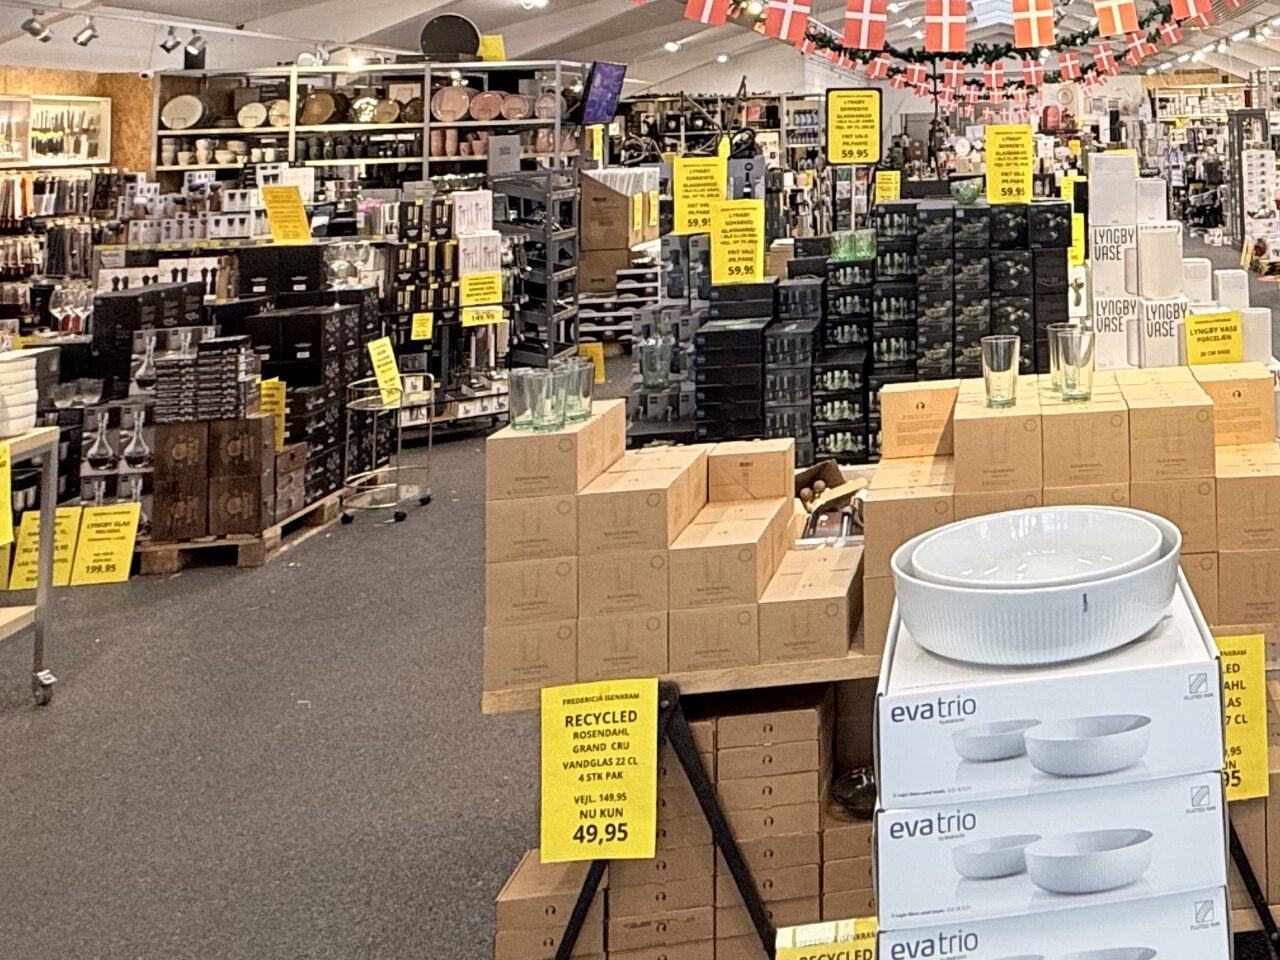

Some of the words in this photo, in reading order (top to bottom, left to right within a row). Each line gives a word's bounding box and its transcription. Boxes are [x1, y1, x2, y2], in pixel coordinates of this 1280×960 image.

[841, 149, 869, 159] 59,95
[1001, 187, 1025, 197] 59,95
[1093, 228, 1135, 245] LYNGBY
[1094, 244, 1122, 261] VASE
[727, 265, 755, 276] 59,95
[1096, 299, 1137, 317] LYNGBY
[1145, 301, 1188, 321] LYNGBY
[1096, 316, 1124, 333] VASE
[1146, 320, 1175, 338] VASE
[1190, 326, 1218, 336] LYNGBY
[1219, 325, 1238, 333] VASE
[86, 563, 117, 574] 199,95
[1224, 680, 1246, 690] AHL
[562, 694, 604, 706] FREDERICIA
[604, 692, 640, 702] ISENKRAM
[1225, 697, 1242, 708] AS
[564, 710, 638, 728] RECYCLED
[1234, 714, 1248, 725] CL
[573, 728, 630, 740] ROSENDAHL
[572, 743, 607, 754] GRAND
[611, 741, 630, 751] CRU
[562, 757, 613, 770] VANDGLAS
[615, 757, 626, 766] 22
[627, 756, 639, 766] CL
[578, 774, 585, 782] 4
[586, 772, 604, 782] STK
[605, 771, 623, 780] PAK
[573, 793, 596, 806] VEJL.
[599, 792, 628, 803] 149,95
[579, 808, 597, 820] NU
[599, 807, 624, 819] KUN
[573, 822, 629, 845] 49,95
